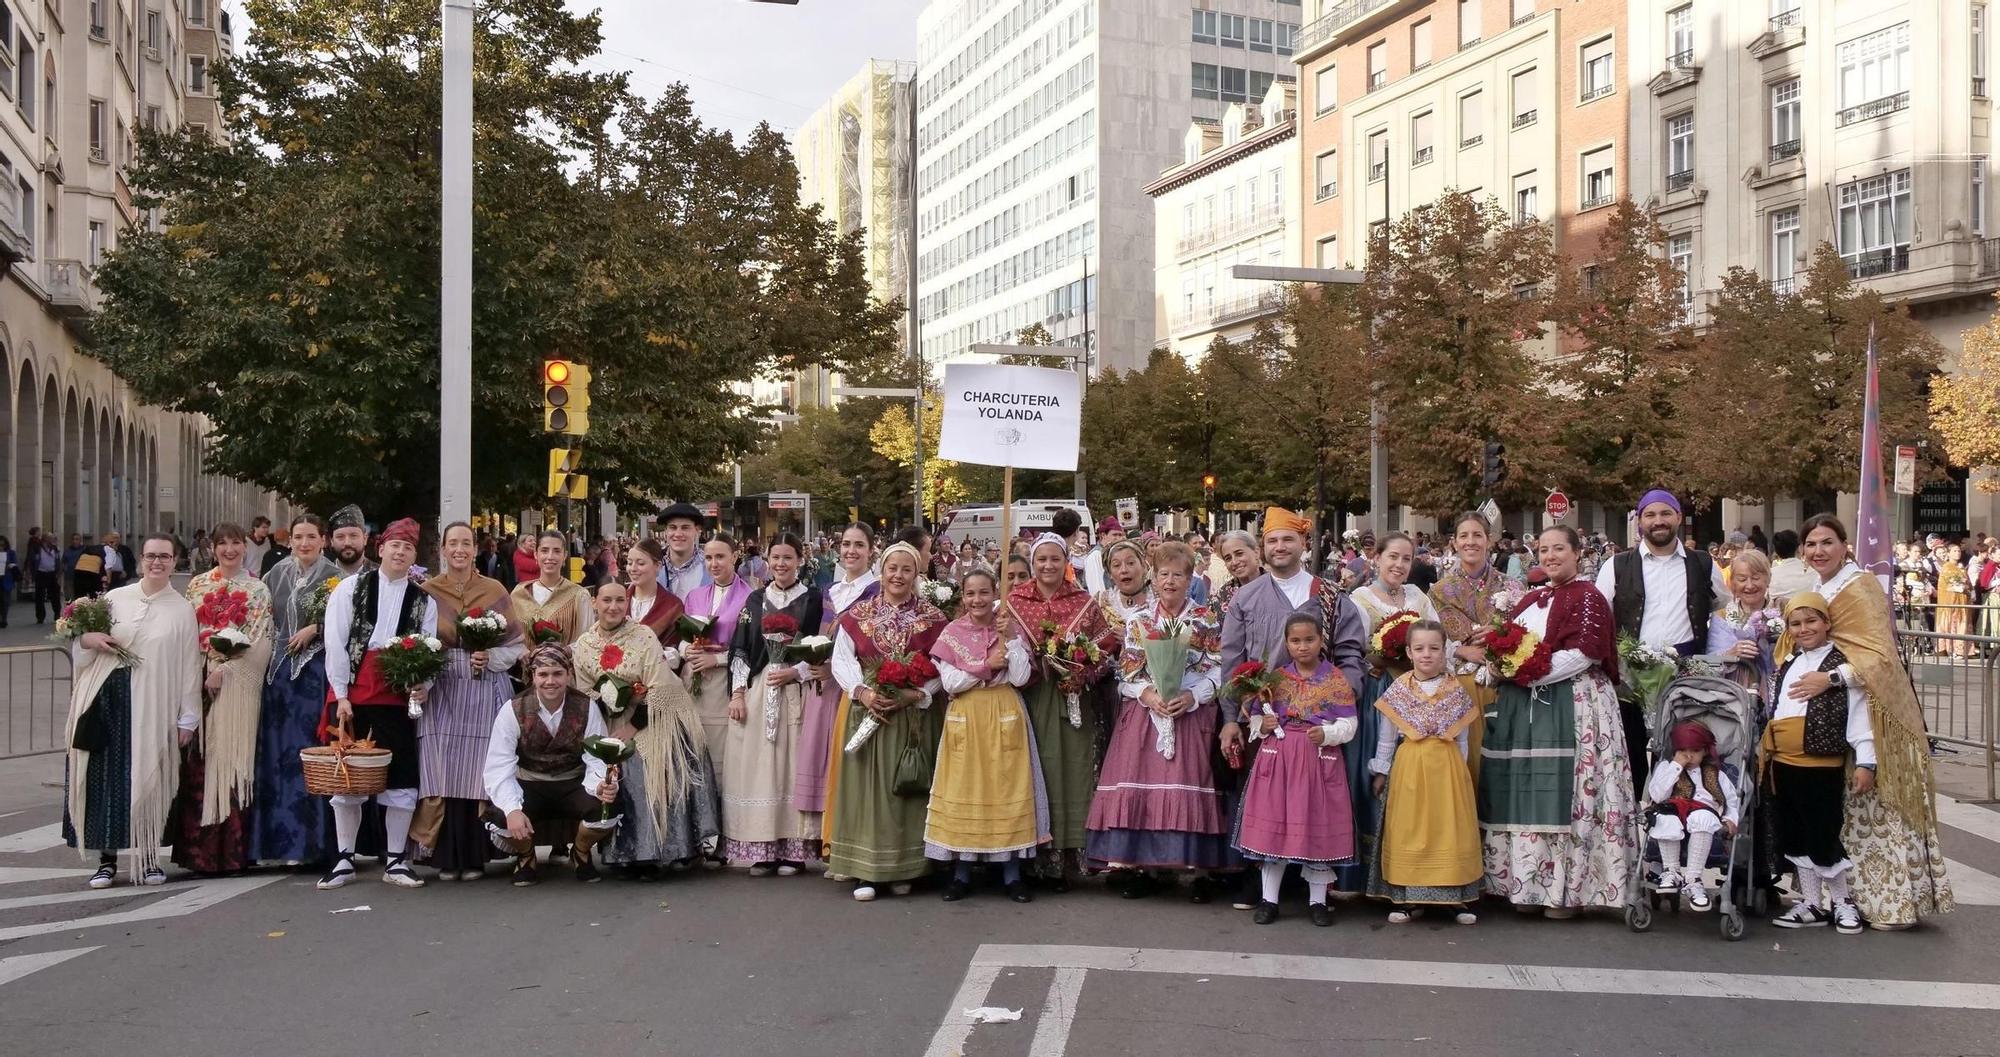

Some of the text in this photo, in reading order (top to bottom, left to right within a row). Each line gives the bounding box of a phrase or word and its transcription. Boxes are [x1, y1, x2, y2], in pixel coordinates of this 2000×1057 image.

[963, 391, 1060, 407] CHARCUTERIA
[978, 407, 1043, 421] YOLANDA
[1548, 502, 1567, 510] STOP
[1026, 513, 1054, 521] AMBU
